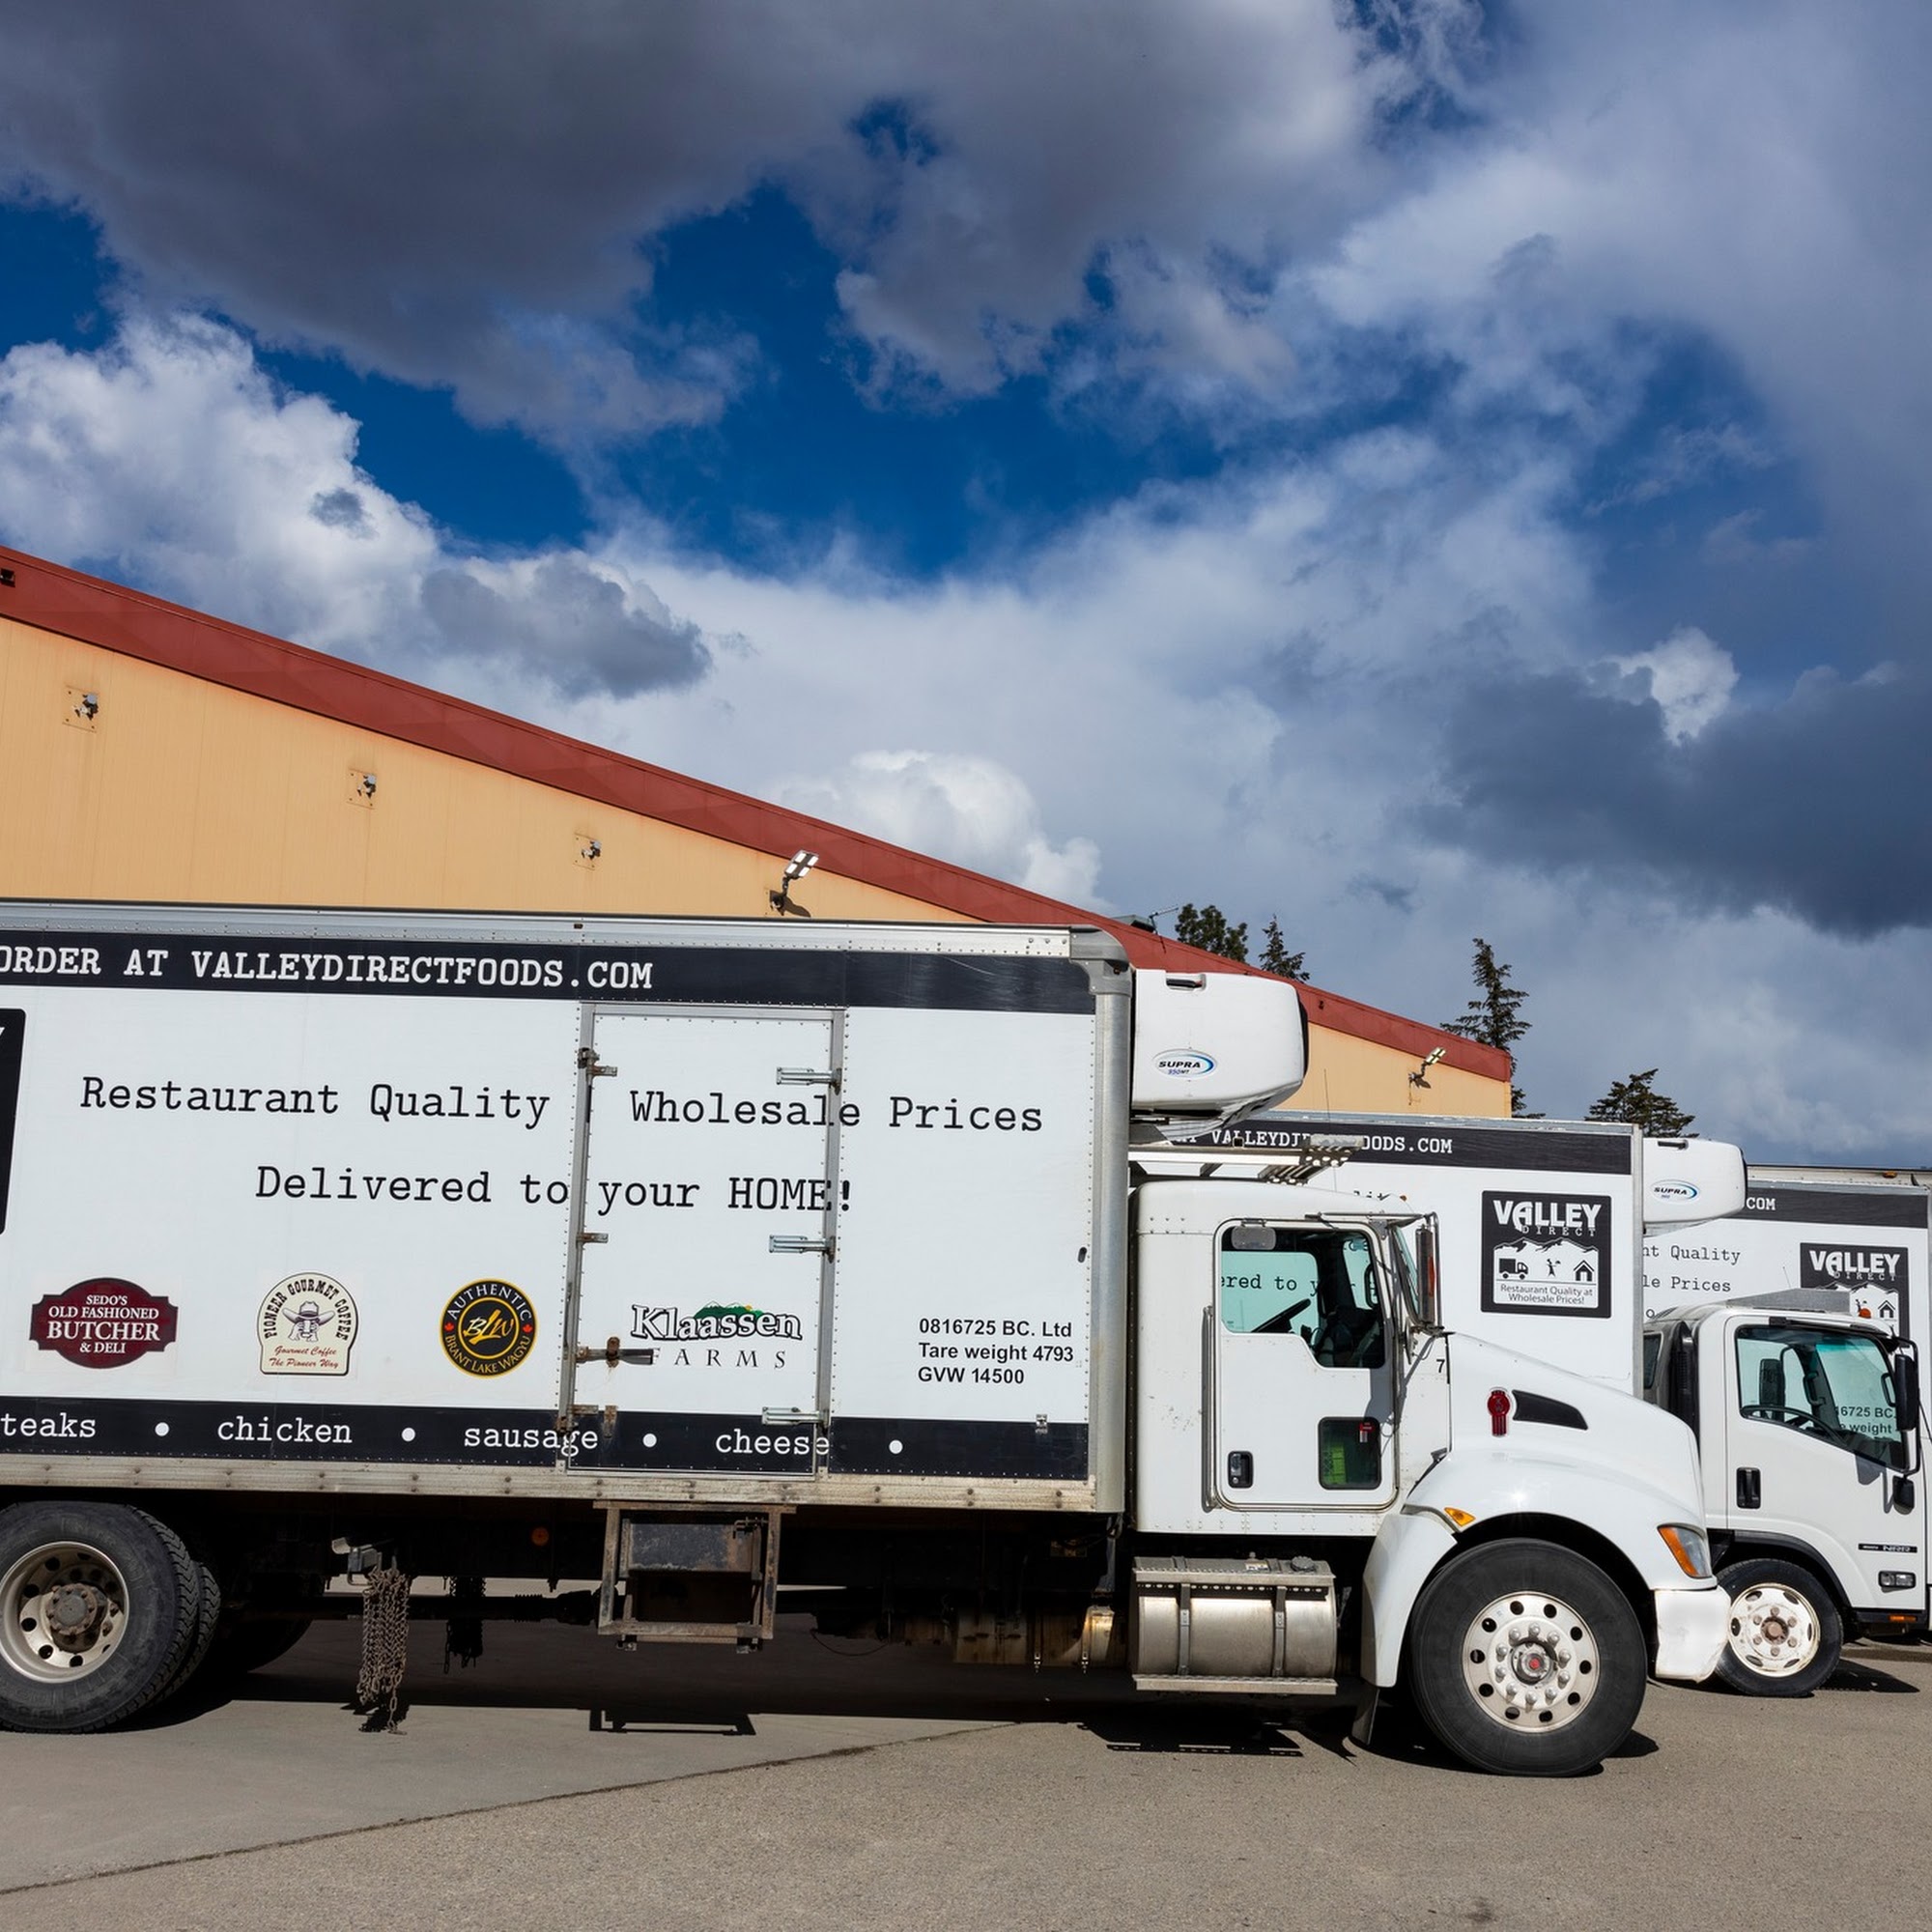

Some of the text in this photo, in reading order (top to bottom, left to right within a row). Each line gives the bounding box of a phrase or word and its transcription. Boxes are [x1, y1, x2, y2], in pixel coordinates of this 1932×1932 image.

[124, 949, 168, 976] AT
[191, 951, 653, 989] VALLEYDIRECTFOODS.COM
[80, 1076, 1043, 1132] Restaurant Quality Wholesale Prices
[255, 1165, 851, 1216] Delivered to your HOME!
[1492, 1200, 1602, 1233] VALLEY
[1521, 1226, 1597, 1236] DIRECT
[1670, 1245, 1741, 1265] Quality
[1808, 1250, 1900, 1276] VALLEY
[1274, 1276, 1297, 1291] to
[1670, 1276, 1731, 1292] Prices
[1833, 1270, 1896, 1281] DIRECT
[86, 1294, 128, 1305] SEDO'S
[1500, 1284, 1548, 1294] Restaurant
[1549, 1286, 1582, 1297] Quality
[1508, 1293, 1585, 1305] Wholesale Prices!
[263, 1278, 353, 1341] PIONEER GOURMET COFFEE
[446, 1284, 532, 1321] AUTHENTIC
[48, 1306, 159, 1320] OLD FASHIONED
[46, 1321, 160, 1341] BUTCHER
[631, 1304, 803, 1341] Klaassen
[919, 1318, 1072, 1337] 0816725 BC. Ltd
[79, 1342, 127, 1353] & DELI
[274, 1345, 337, 1357] Gourmet Coffee
[444, 1334, 531, 1374] BRANT LAKE WAGYU
[919, 1342, 1074, 1363] Tare weight 4793
[269, 1357, 339, 1369] The Pioneer Way
[1435, 1359, 1445, 1373] 7
[918, 1366, 1025, 1383] GVW 14500
[1, 1412, 831, 1458] teaks chicken sausage cheese
[1849, 1422, 1892, 1435] weight
